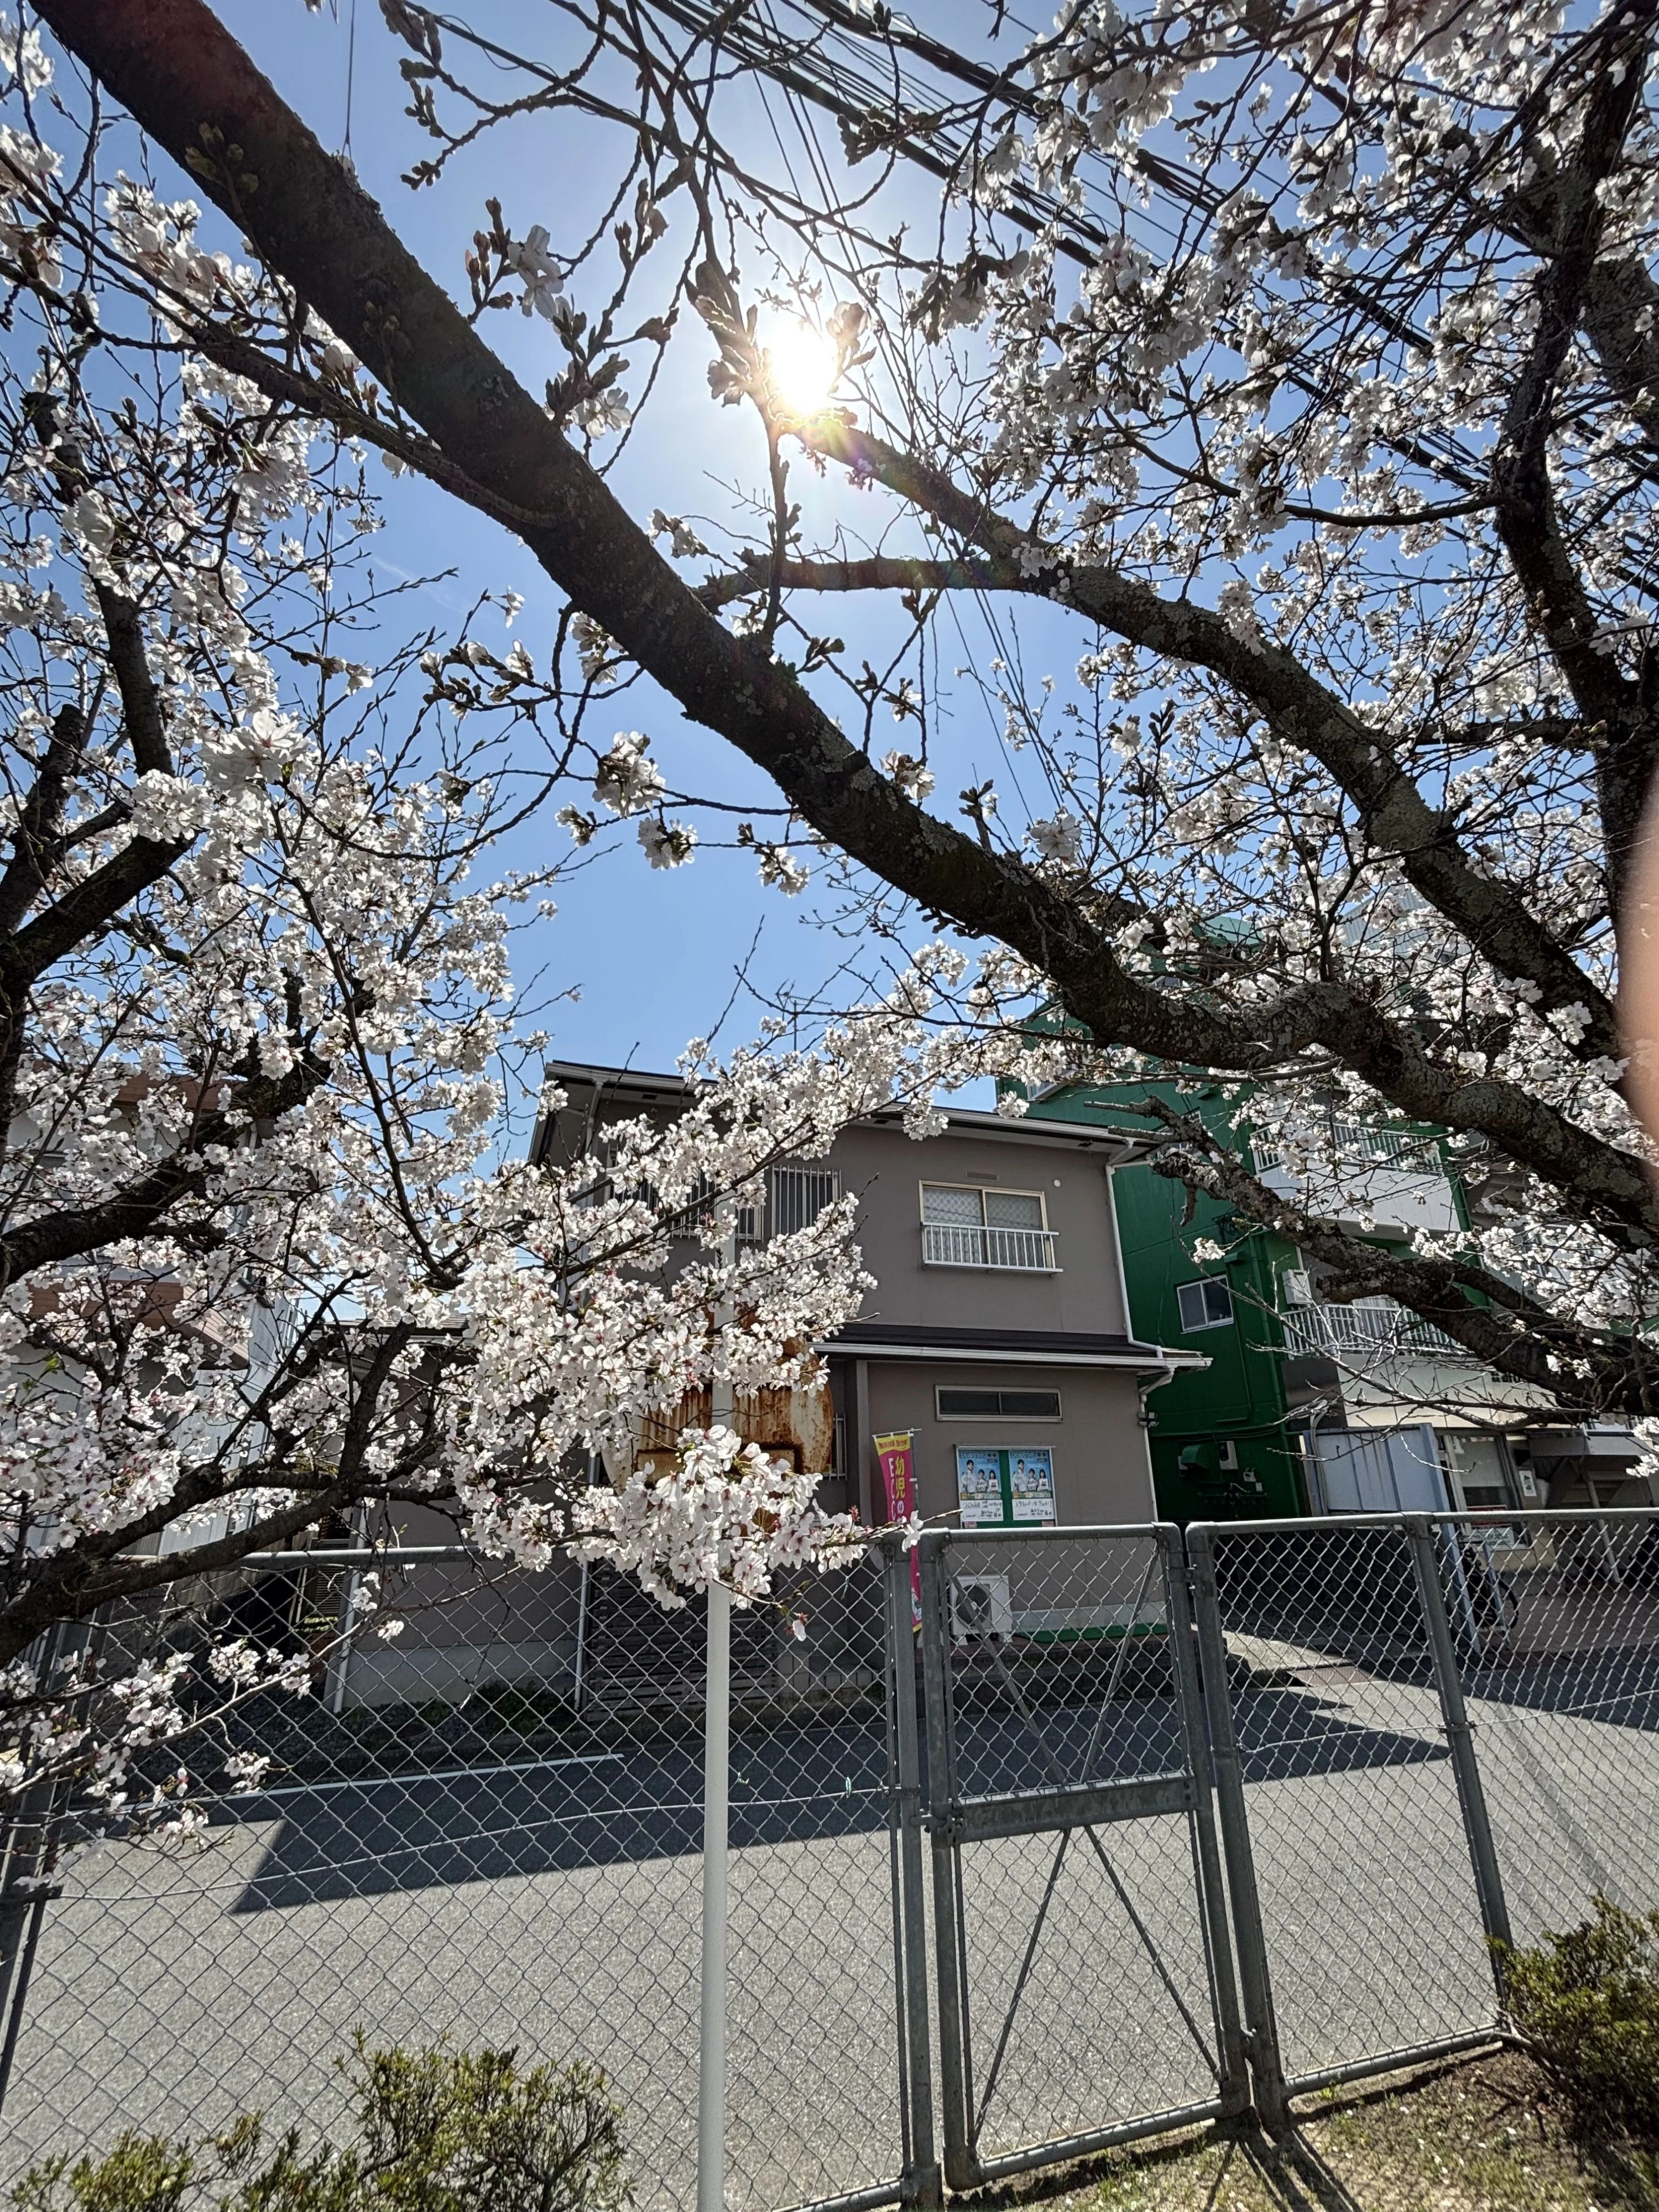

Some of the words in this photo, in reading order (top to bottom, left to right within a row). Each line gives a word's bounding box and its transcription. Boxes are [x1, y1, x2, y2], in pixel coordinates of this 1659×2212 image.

[888, 1458, 896, 1521] ECC
[895, 1455, 906, 1522] 幼児の
